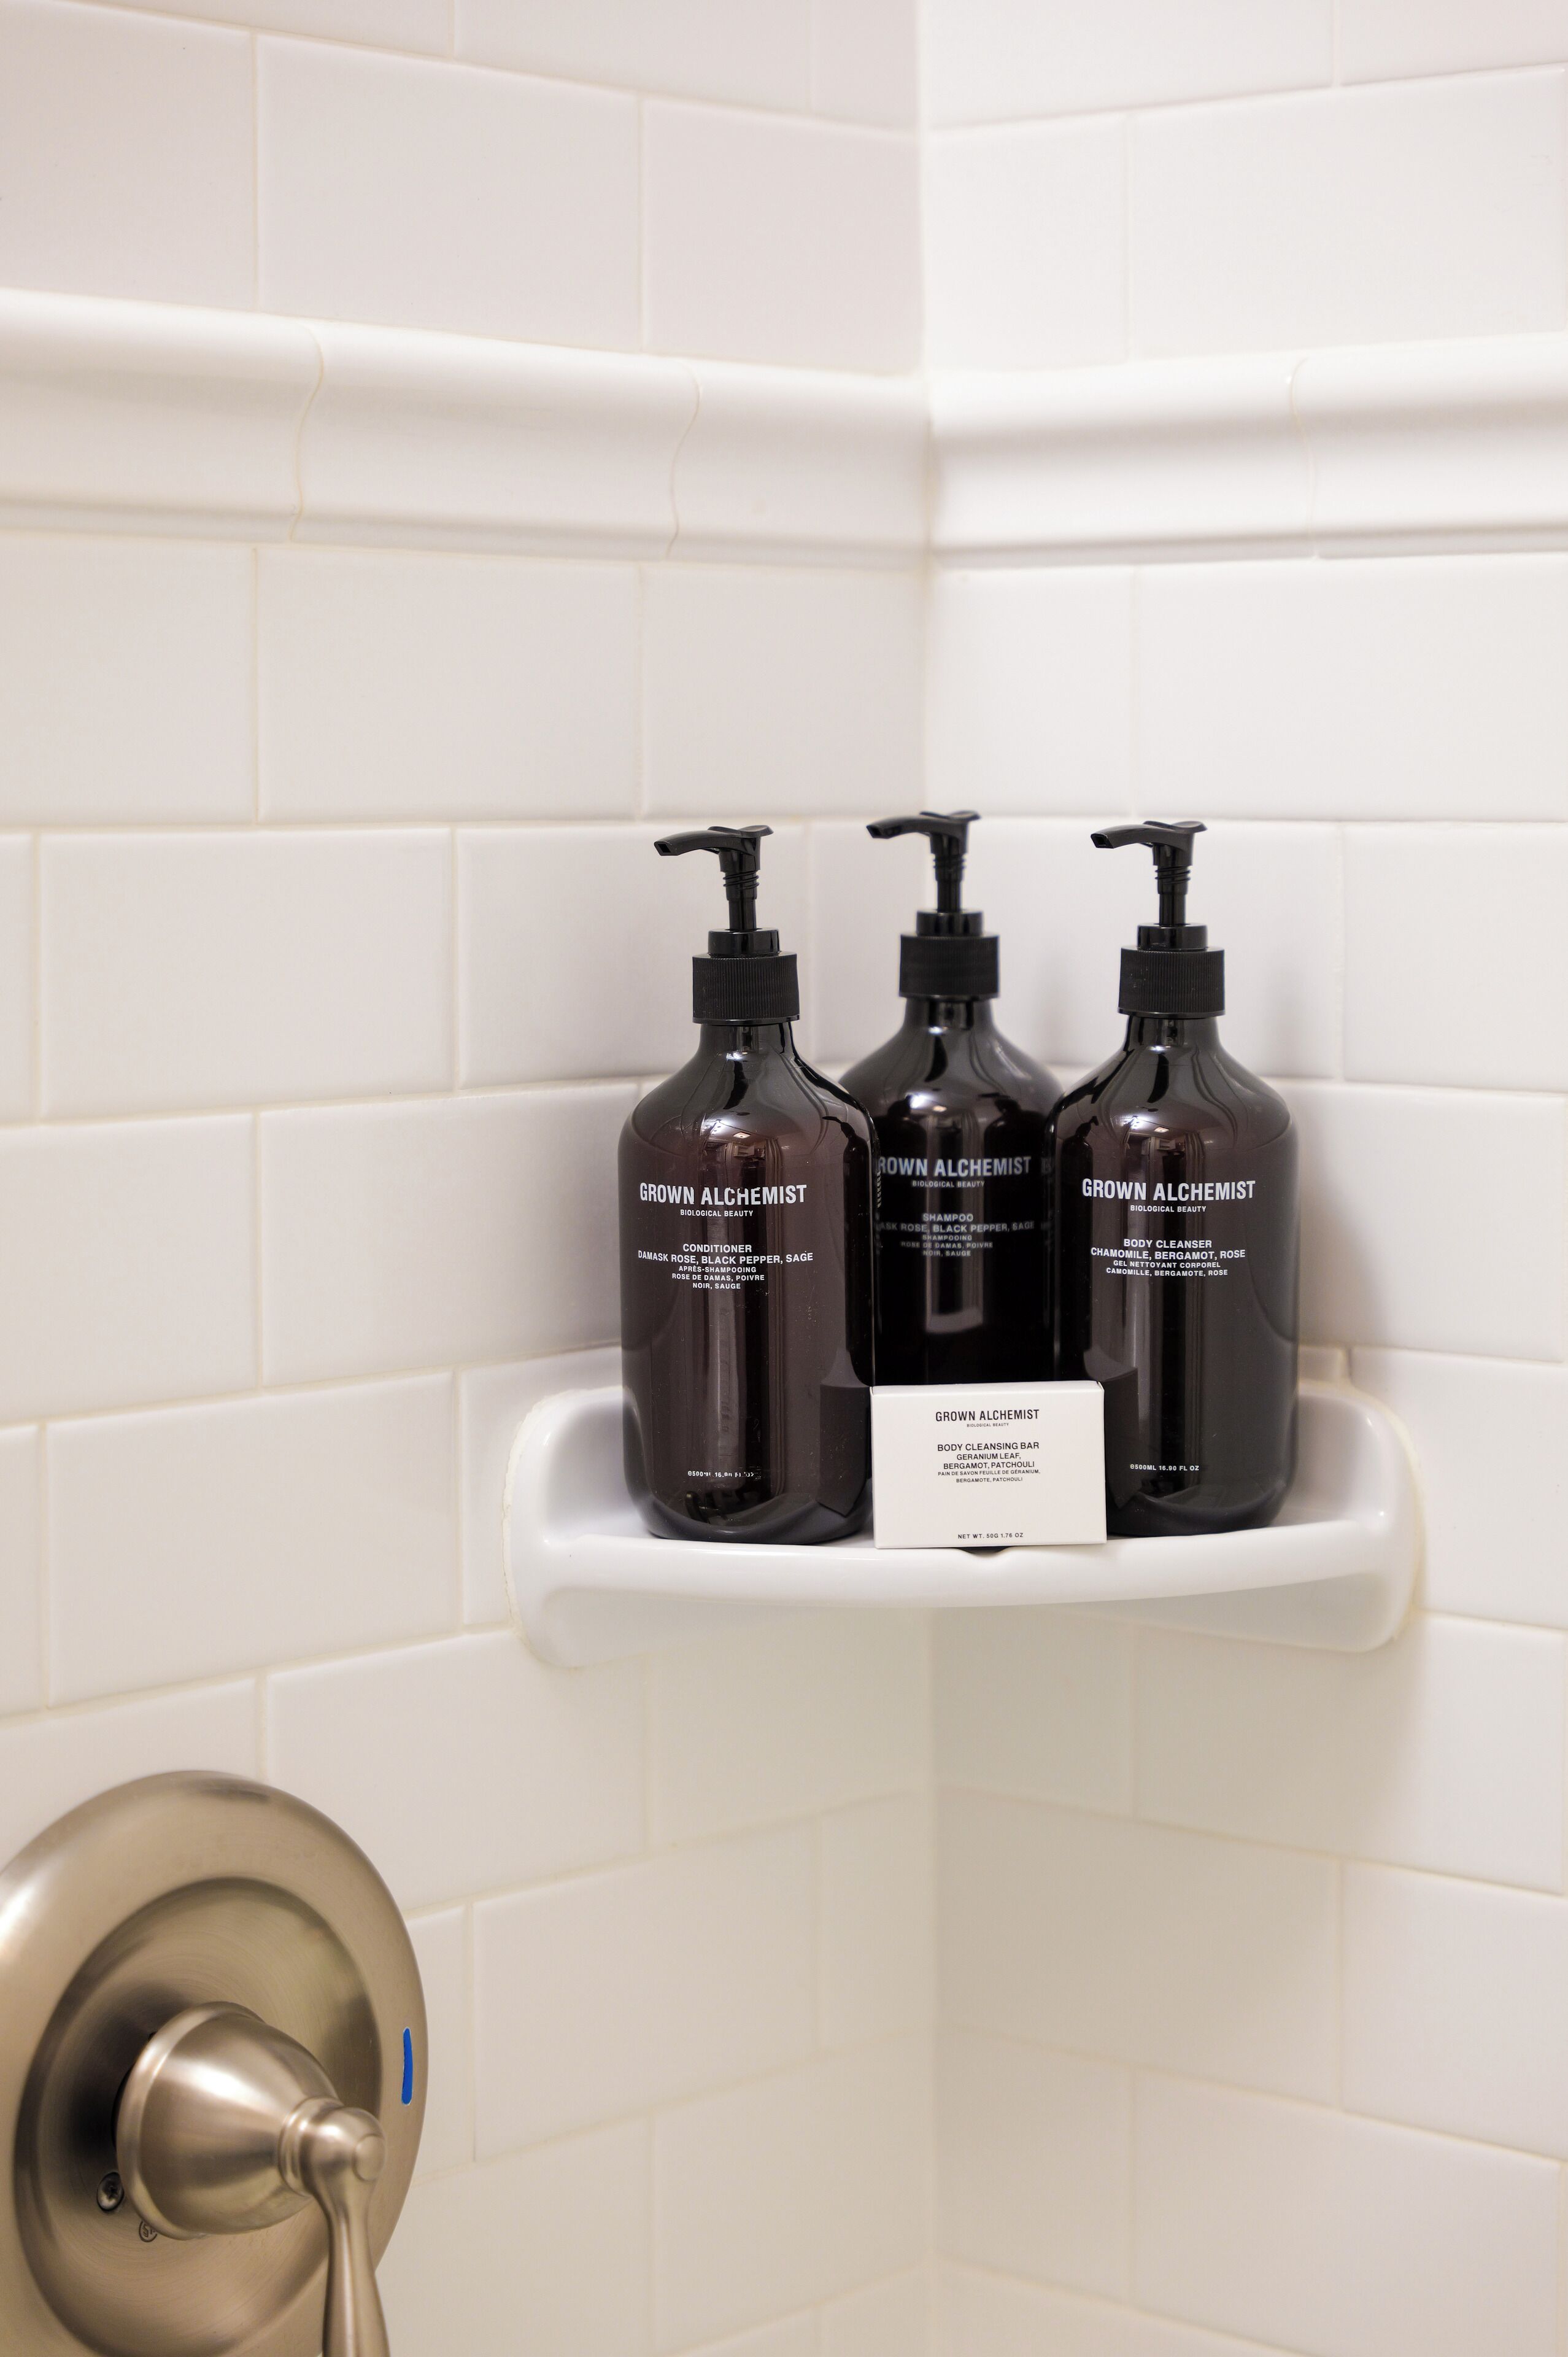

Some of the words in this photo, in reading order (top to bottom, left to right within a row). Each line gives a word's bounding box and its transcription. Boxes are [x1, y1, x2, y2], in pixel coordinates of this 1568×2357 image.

[878, 1156, 927, 1177] ROWN
[933, 1156, 1032, 1177] ALCHEMIST
[640, 1182, 694, 1204] GROWN
[701, 1184, 807, 1206] ALCHEMIST
[1082, 1178, 1146, 1201] GROWN
[1153, 1180, 1256, 1201] ALCHEMIST
[923, 1213, 973, 1222] SHAMPOO
[901, 1223, 930, 1233] ROSE,
[933, 1224, 967, 1233] BLACK
[971, 1224, 1010, 1233] PEPPER,
[682, 1244, 752, 1253] CONDITIONER
[1124, 1239, 1153, 1248] BODY
[1156, 1240, 1212, 1248] CLEANSER
[638, 1250, 668, 1262] DAMASK
[671, 1254, 699, 1265] ROSE,
[701, 1256, 736, 1264] BLACK
[740, 1255, 782, 1264] PEPPER,
[786, 1252, 813, 1263] SAGE
[1091, 1247, 1152, 1261] CHAMOMILE,
[1154, 1251, 1218, 1261] BERGAMOT,
[1220, 1250, 1245, 1258] ROSE
[679, 1264, 756, 1273] APRÈS-SHAMPOOING
[1106, 1268, 1152, 1277] CAMOMILLE,
[935, 1411, 975, 1422] GROWN
[979, 1409, 1039, 1420] ALCHEMIST
